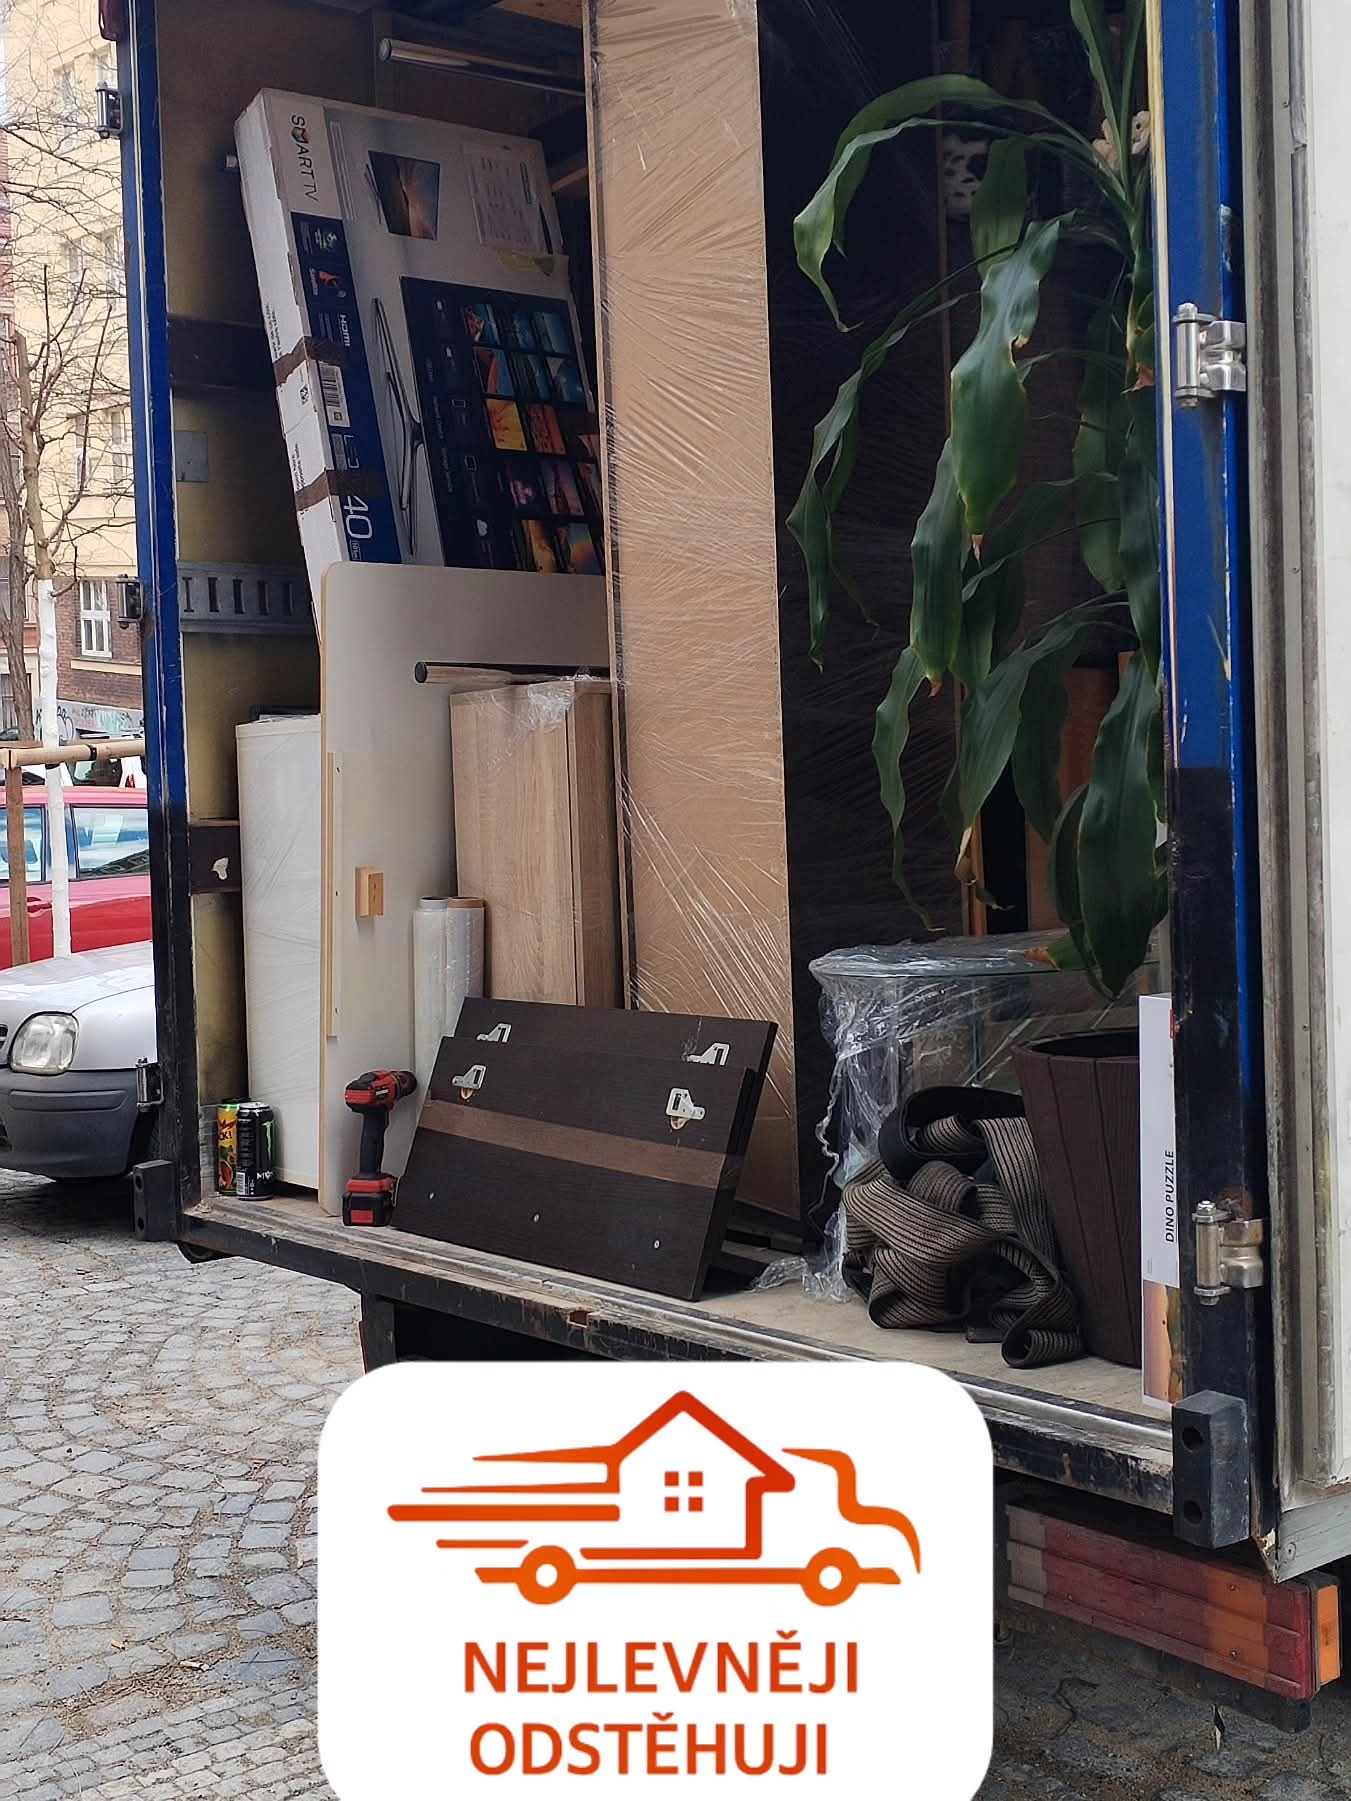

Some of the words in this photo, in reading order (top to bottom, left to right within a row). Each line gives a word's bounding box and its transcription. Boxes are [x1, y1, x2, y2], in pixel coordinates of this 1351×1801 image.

[291, 114, 315, 180] SMART
[303, 183, 319, 202] TV
[339, 314, 351, 347] HDMI
[343, 495, 373, 539] 40
[1164, 1150, 1175, 1203] PUZZLE
[1165, 1206, 1175, 1243] DINO
